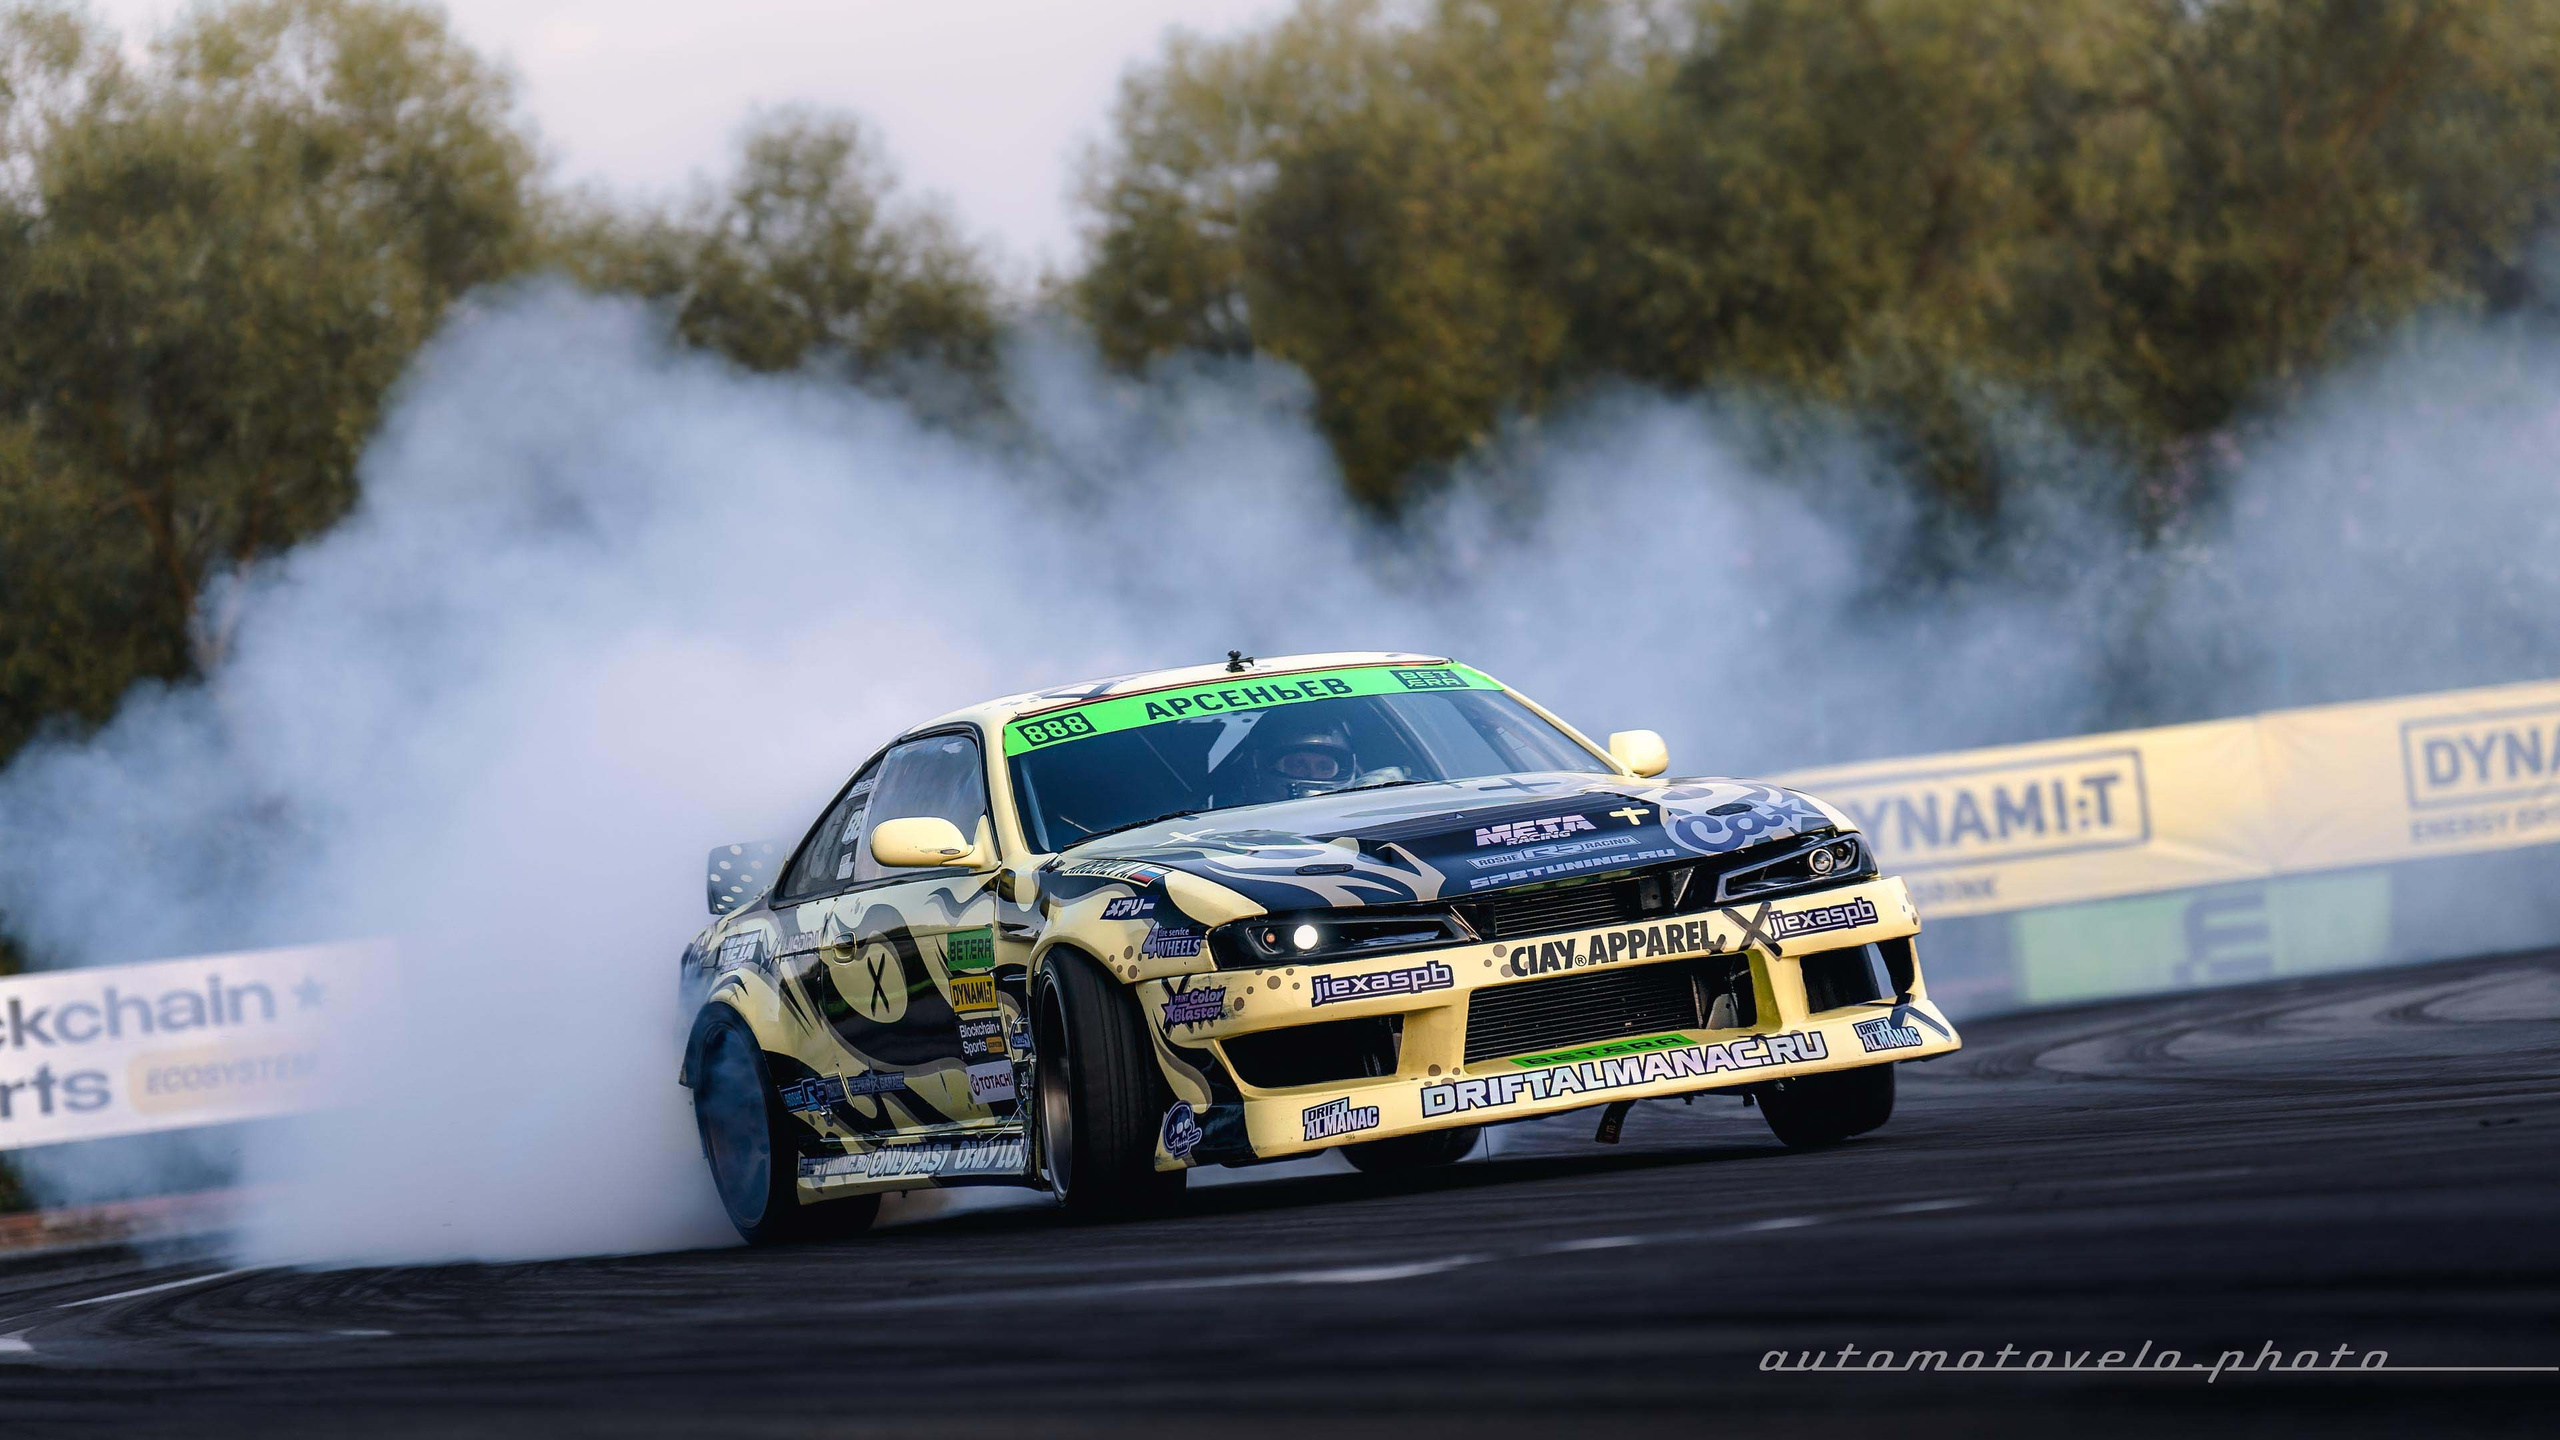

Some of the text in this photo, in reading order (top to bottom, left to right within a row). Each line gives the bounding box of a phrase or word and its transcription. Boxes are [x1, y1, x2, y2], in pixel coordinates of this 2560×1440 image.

[1145, 678, 1353, 720] АРСЕНЬЕВ
[1023, 715, 1089, 743] 888
[2424, 727, 2560, 786] DYN
[1847, 772, 2120, 853] YNAMI:T
[1475, 814, 1597, 847] META
[1506, 829, 1571, 846] RACING
[1479, 854, 1519, 866] ROSHE
[1585, 837, 1631, 849] RACING
[1470, 848, 1677, 889] SPBTUNING.RU
[1105, 898, 1155, 917] メアリー
[1769, 899, 1877, 940] jiexaspb
[1142, 921, 1201, 958] 4 WHEELS
[1588, 920, 1715, 966] APPAREL
[1190, 989, 1224, 1004] Color
[1314, 963, 1451, 1004] jiexaspb
[0, 973, 278, 1052] kchain
[1174, 1006, 1221, 1023] Blaster
[1858, 1019, 1888, 1036] DRIFT
[959, 1021, 997, 1039] Blockchain
[1862, 1026, 1923, 1053] ALMANAC
[963, 1039, 988, 1056] Sports
[1421, 1032, 1828, 1118] DRIFTALMANAC.RU
[1306, 1106, 1378, 1140] ALMANAC
[1308, 1101, 1345, 1122] DRIFT
